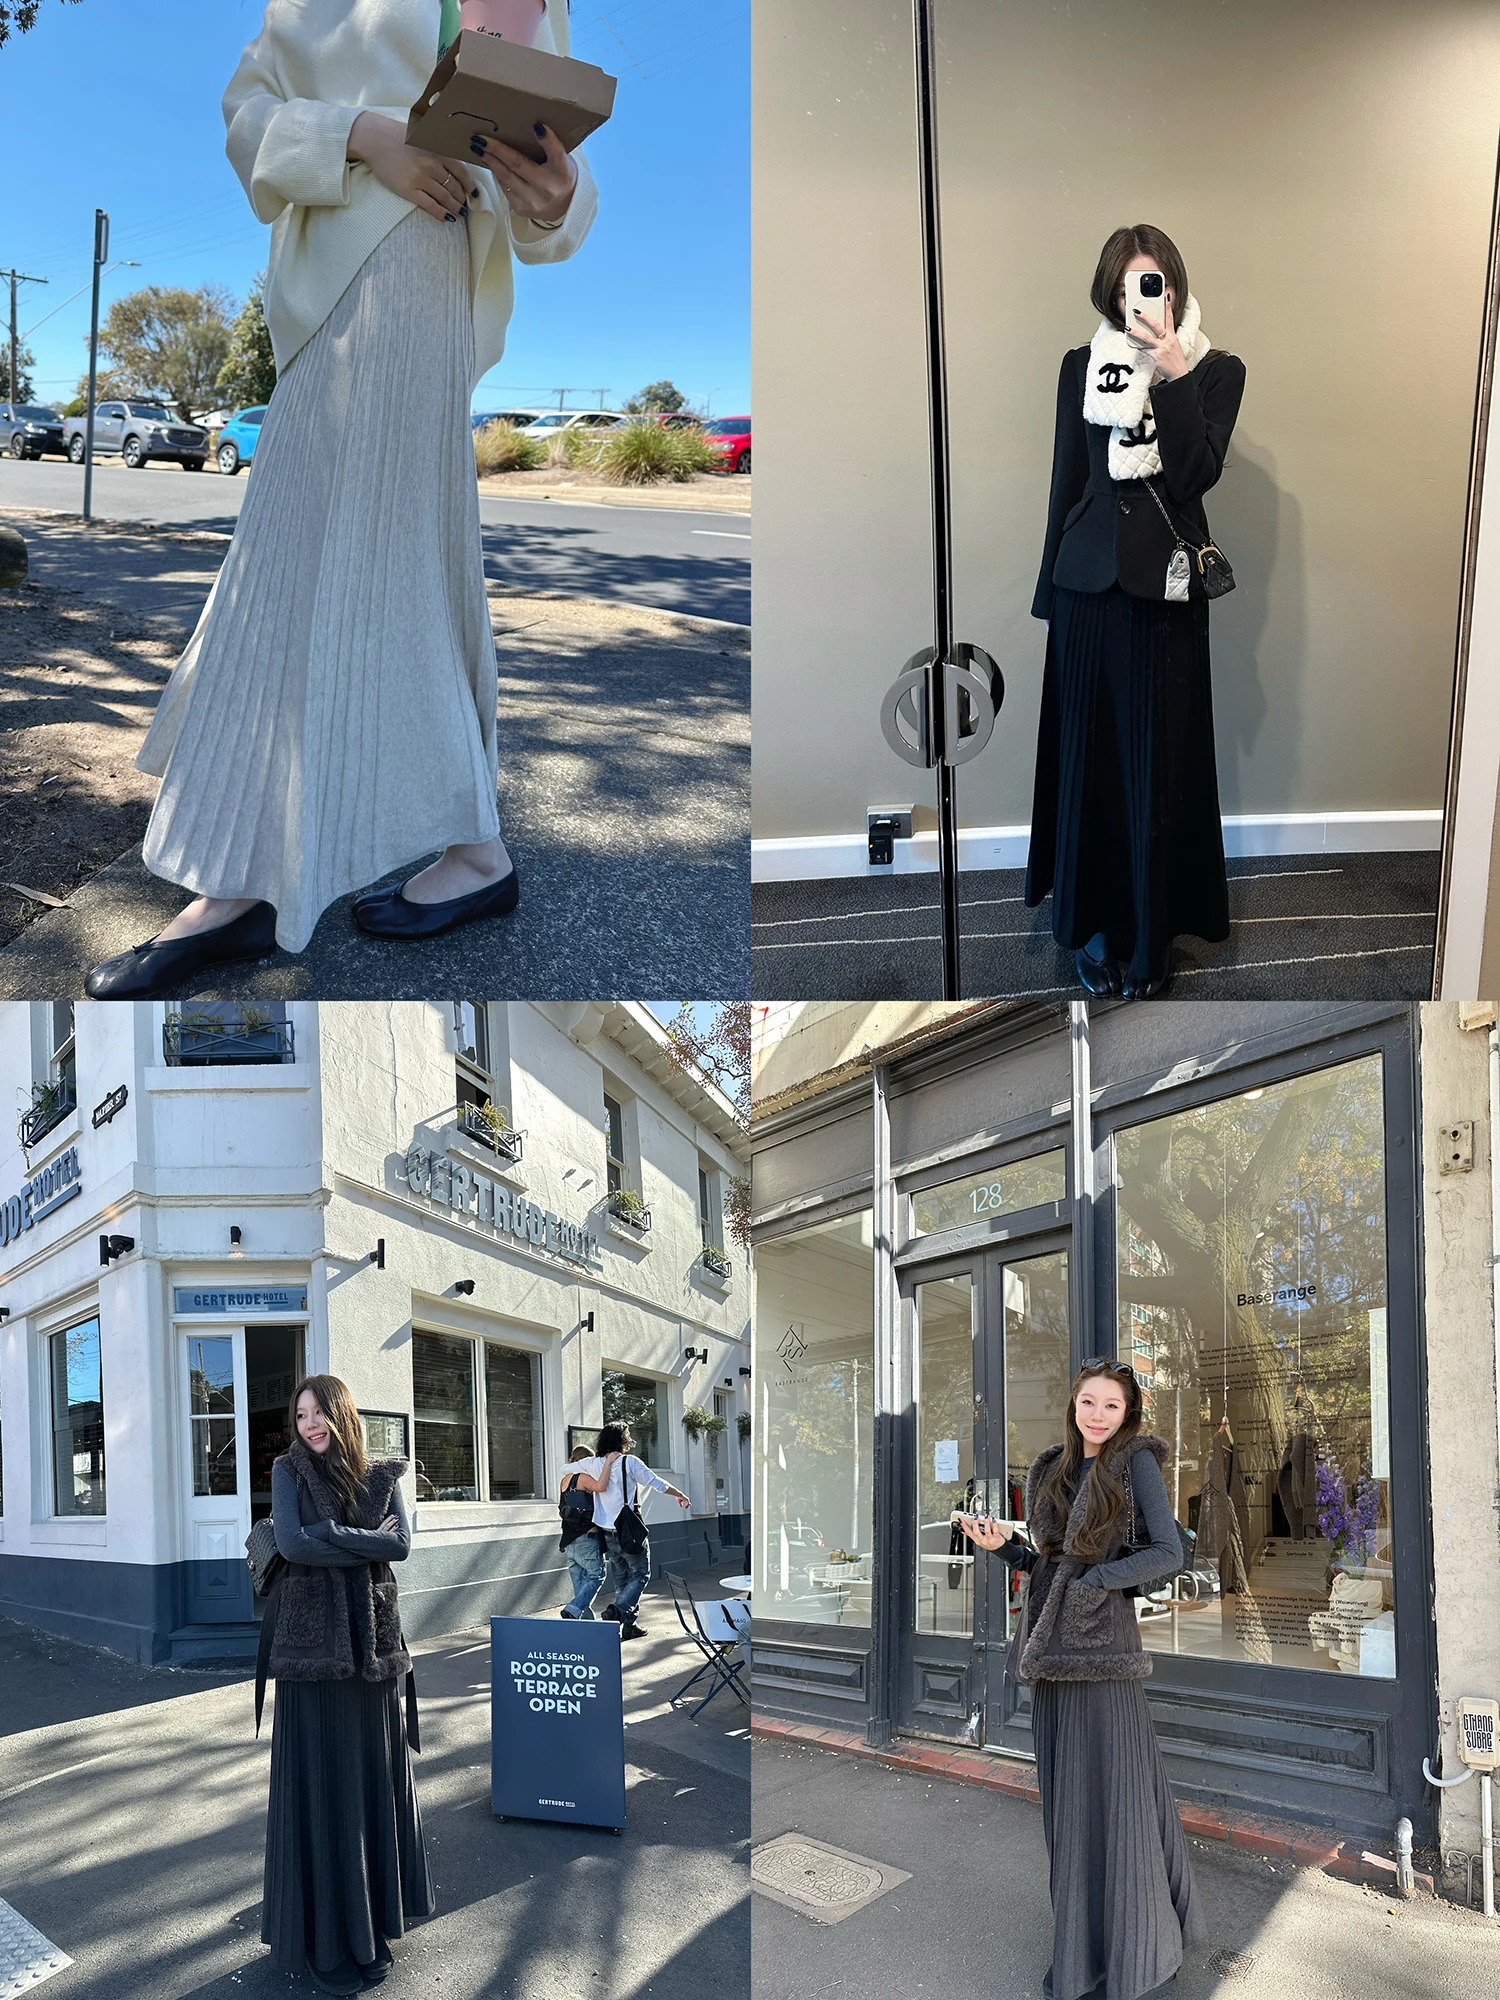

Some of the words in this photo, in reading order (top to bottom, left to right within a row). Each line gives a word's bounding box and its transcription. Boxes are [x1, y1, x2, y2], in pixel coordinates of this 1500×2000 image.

[33, 1146, 79, 1206] HOTEL
[407, 1141, 561, 1253] GERTRUDE
[560, 1217, 601, 1259] HOTEL
[970, 1183, 1002, 1214] 128
[194, 1294, 260, 1306] GERTRUDE
[1237, 1285, 1316, 1306] Baserange
[775, 1377, 808, 1386] BASERANGE
[546, 1652, 584, 1661] SEASON
[510, 1661, 600, 1680] ROOFTOP
[514, 1678, 597, 1698] TERRACE
[529, 1698, 581, 1715] OPEN
